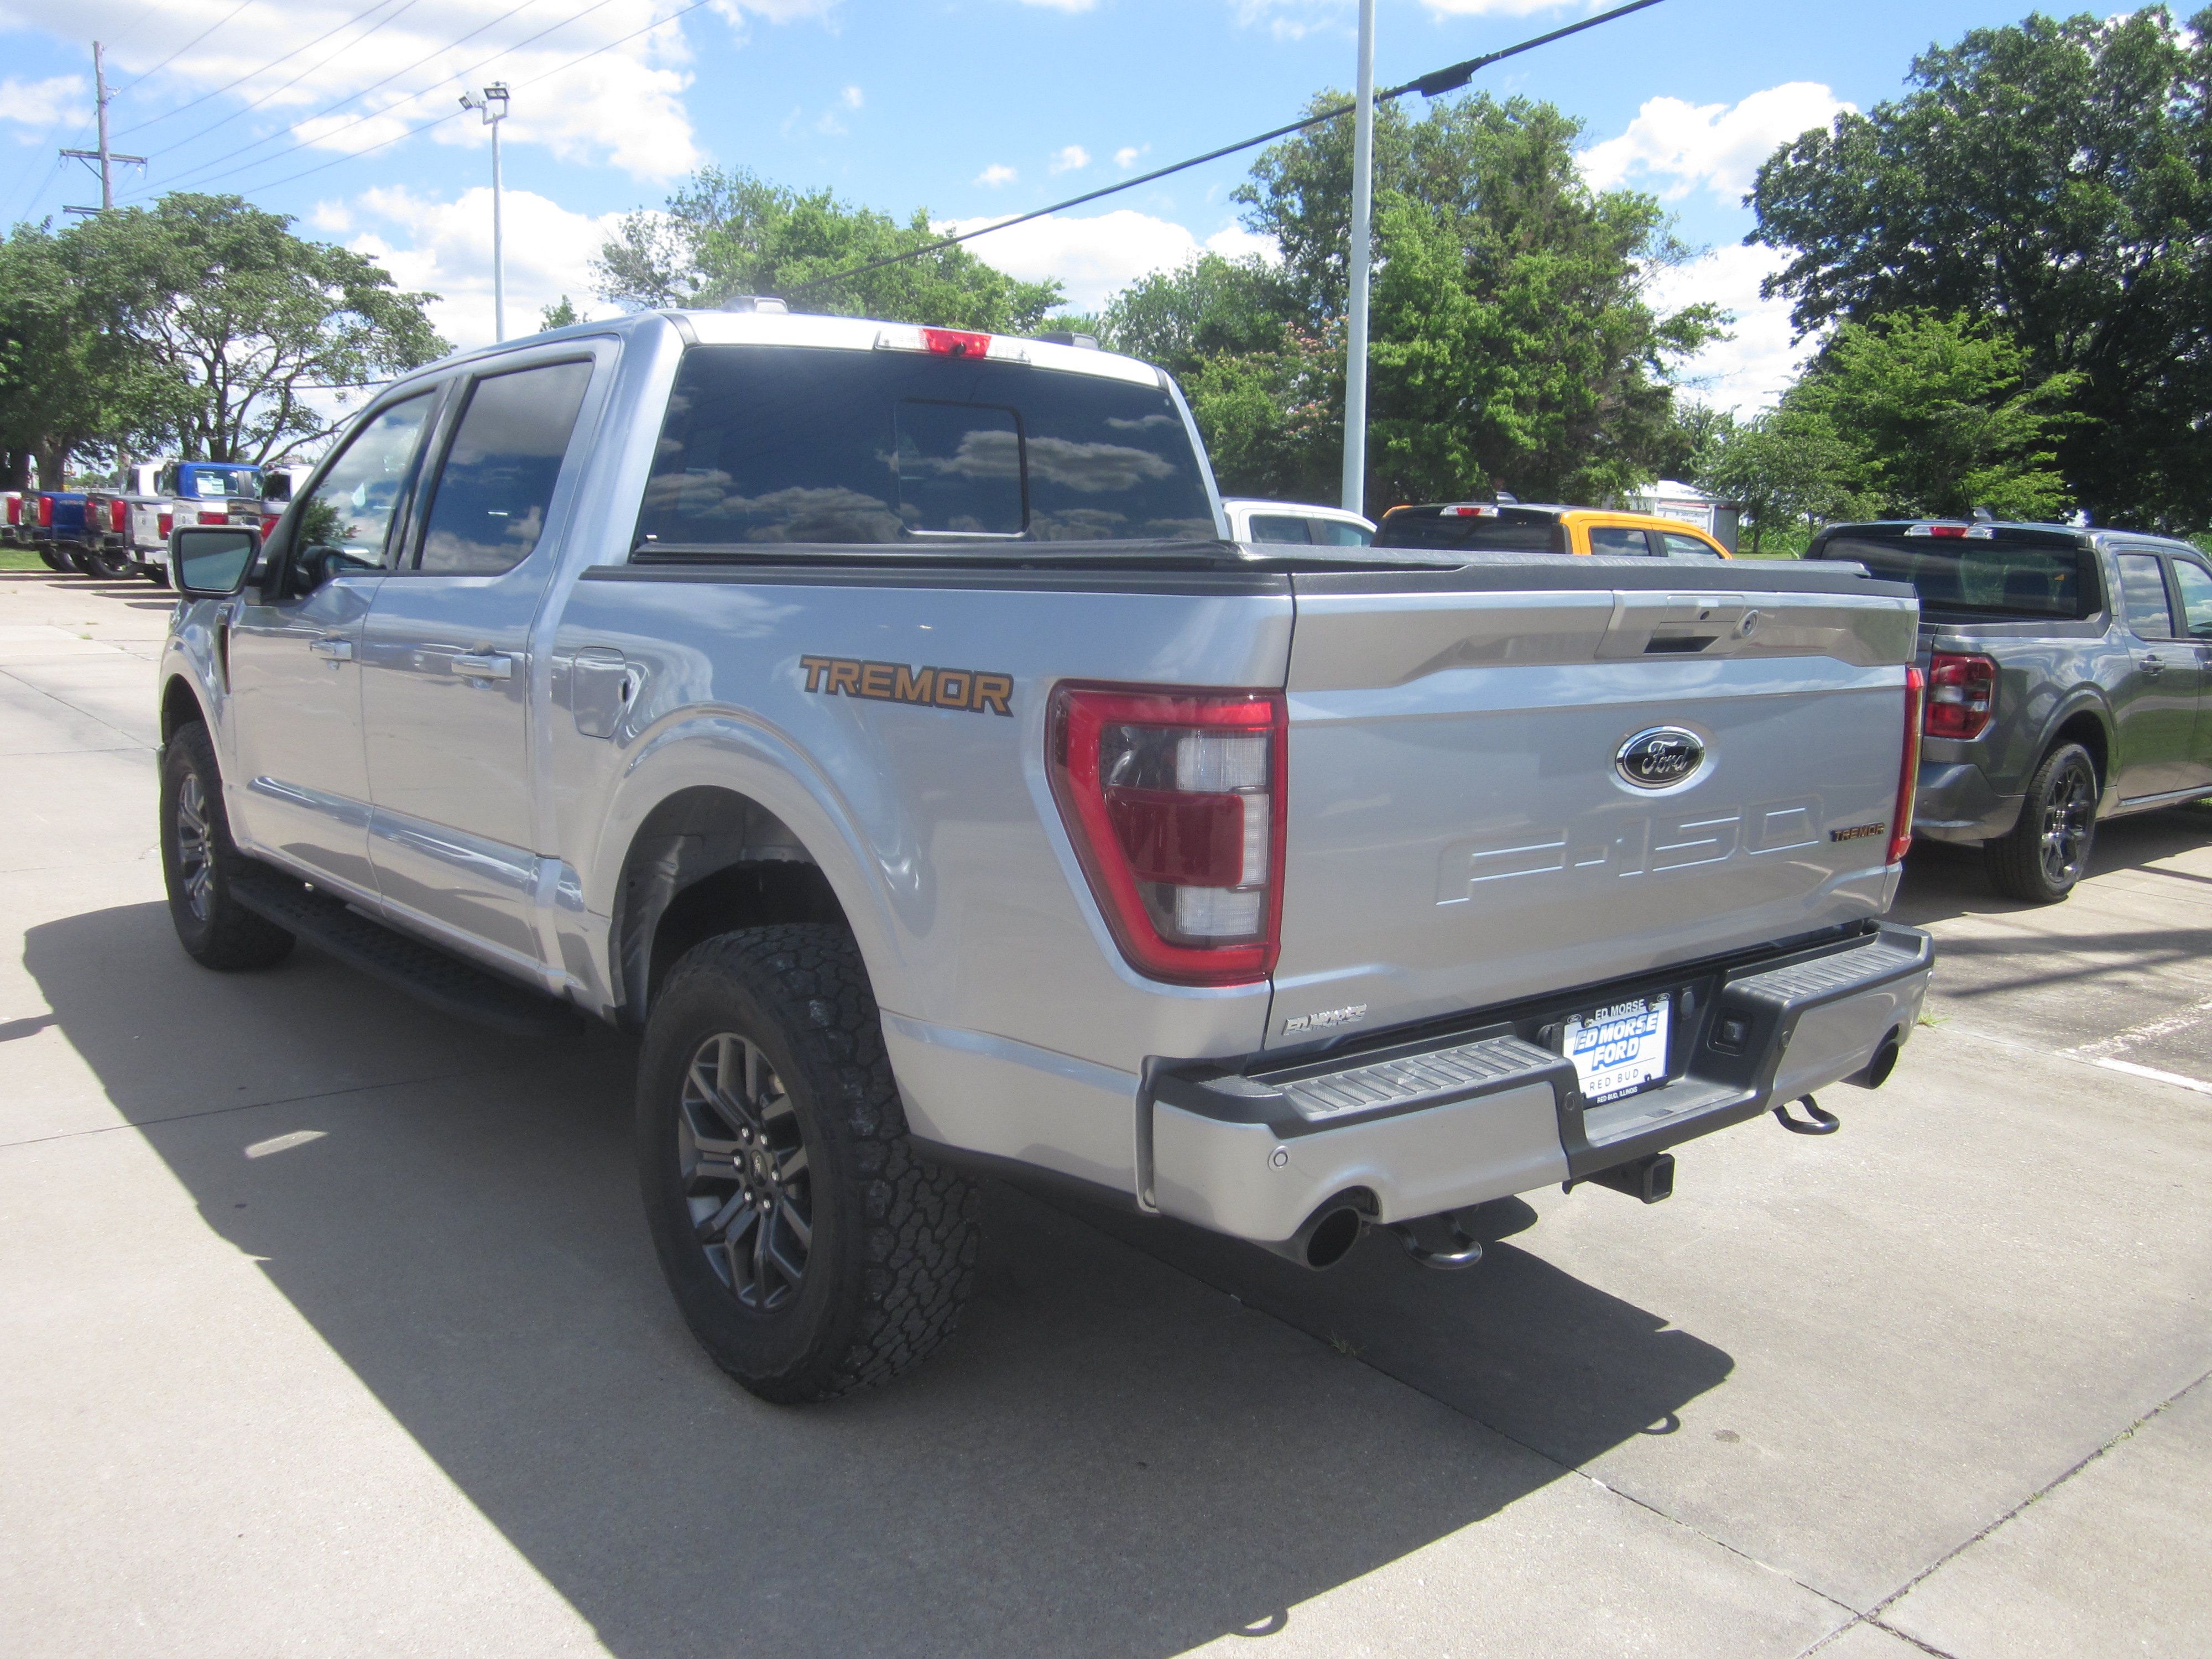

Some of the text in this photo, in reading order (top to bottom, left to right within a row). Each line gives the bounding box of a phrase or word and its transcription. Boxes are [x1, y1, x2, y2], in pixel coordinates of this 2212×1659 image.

[799, 654, 1014, 717] TREMOR
[1641, 740, 1689, 774] Ford
[1829, 822, 1885, 842] TREMOR
[1436, 794, 1825, 906] F-150
[1595, 1008, 1609, 1020] ED
[1611, 999, 1645, 1016] MORSE
[1574, 1010, 1659, 1054] ED MORSE
[1592, 1037, 1640, 1071] FORD
[1589, 1068, 1639, 1092] RED BUD
[1619, 1087, 1638, 1097] ILLINOIS
